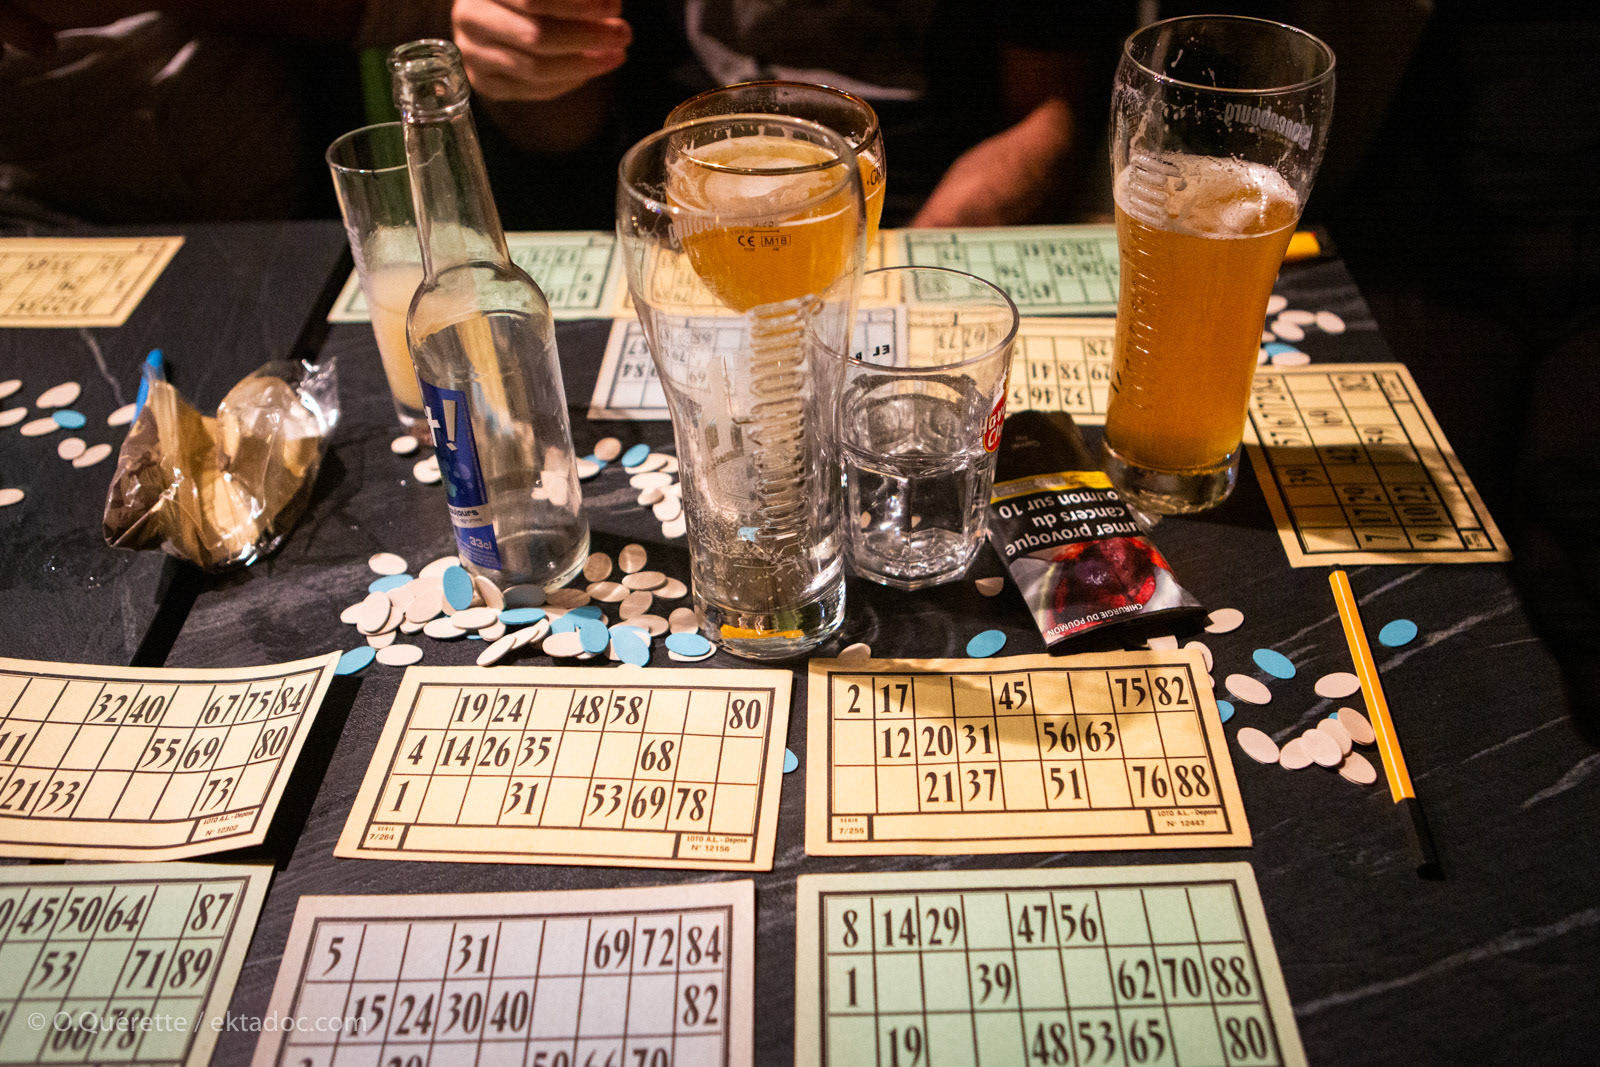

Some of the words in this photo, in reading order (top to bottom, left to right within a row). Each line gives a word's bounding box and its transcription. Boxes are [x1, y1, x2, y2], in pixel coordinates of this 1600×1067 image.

[764, 236, 787, 245] M18
[1031, 363, 1049, 380] 41
[1061, 363, 1080, 380] 38
[1032, 388, 1052, 405] 46
[1062, 388, 1084, 405] 32
[999, 503, 1022, 519] 10
[1028, 496, 1054, 512] sur
[1057, 490, 1119, 505] oumon
[1032, 513, 1057, 529] du
[1062, 506, 1125, 522] cancers
[1097, 521, 1141, 537] umer
[469, 536, 492, 550] 33cl
[1004, 524, 1093, 556] provoque
[1047, 618, 1086, 637] POUMON
[1086, 613, 1100, 623] DU
[1100, 603, 1143, 620] CHIRURGIE
[89, 693, 128, 723] 32
[129, 695, 165, 723] 40
[204, 694, 241, 724] 67
[245, 690, 273, 721] 75
[275, 683, 308, 715] 84
[847, 684, 861, 713] 2
[880, 684, 909, 713] 17
[998, 681, 1028, 710] 45
[1115, 677, 1146, 708] 75
[1157, 676, 1190, 706] 82
[454, 693, 488, 723] 19
[492, 694, 524, 723] 24
[570, 695, 605, 725] 48
[610, 695, 645, 725] 58
[728, 698, 762, 730] 80
[142, 738, 181, 768] 55
[183, 737, 220, 769] 69
[254, 725, 288, 759] 80
[407, 734, 428, 766] 4
[440, 735, 472, 767] 14
[477, 736, 511, 767] 26
[518, 736, 552, 767] 35
[641, 739, 675, 772] 68
[880, 728, 912, 758] 12
[922, 725, 953, 756] 20
[964, 724, 993, 754] 31
[1044, 722, 1077, 753] 56
[1085, 721, 1116, 752] 63
[0, 779, 41, 812] 21
[37, 781, 81, 813] 33
[200, 777, 234, 812] 73
[925, 771, 954, 802] 21
[967, 769, 997, 801] 37
[1053, 767, 1083, 800] 51
[1133, 765, 1168, 798] 76
[1178, 764, 1211, 797] 88
[389, 780, 410, 812] 1
[504, 782, 540, 815] 31
[589, 784, 624, 817] 53
[631, 785, 666, 819] 69
[674, 788, 708, 821] 78
[203, 817, 219, 825] LOTO
[369, 833, 394, 841] 7/264
[16, 897, 60, 934] 45
[58, 897, 102, 933] 50
[104, 895, 147, 933] 64
[190, 893, 234, 931] 87
[842, 909, 859, 946] 8
[882, 909, 916, 946] 14
[926, 907, 961, 945] 29
[1017, 905, 1048, 943] 47
[1061, 903, 1098, 941] 56
[322, 937, 345, 975] 5
[454, 934, 491, 974] 31
[594, 928, 631, 968] 69
[642, 927, 674, 967] 72
[685, 925, 722, 965] 84
[32, 950, 77, 990] 53
[126, 949, 167, 989] 71
[169, 948, 213, 988] 89
[846, 967, 858, 1006] 1
[977, 962, 1013, 1003] 39
[1117, 959, 1156, 1000] 62
[1163, 957, 1201, 998] 70
[1211, 956, 1251, 997] 88
[348, 994, 385, 1037] 15
[395, 993, 432, 1035] 24
[442, 991, 482, 1034] 30
[490, 990, 529, 1032] 40
[682, 983, 719, 1027] 82
[101, 1007, 145, 1051] 78
[886, 1027, 922, 1067] 19
[1032, 1022, 1070, 1066] 48
[1077, 1021, 1116, 1064] 53
[1128, 1019, 1166, 1062] 65
[1226, 1016, 1267, 1061] 80
